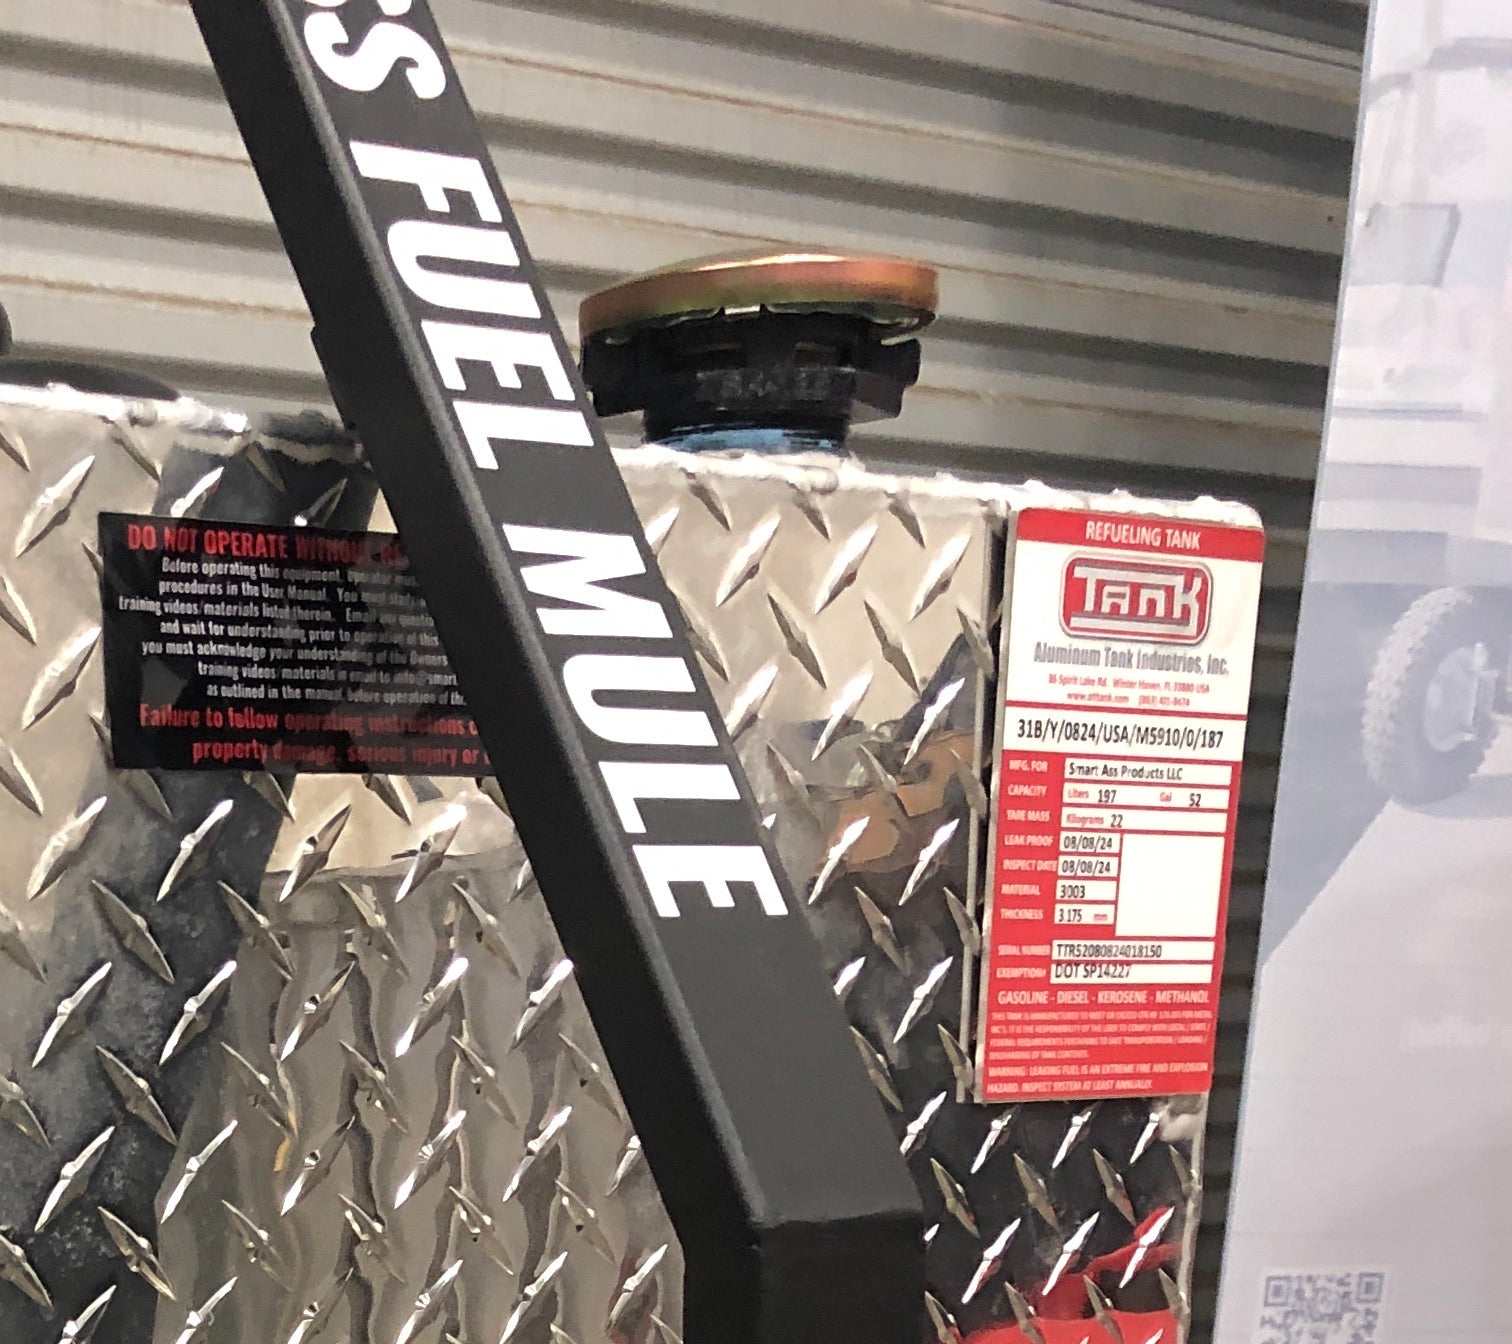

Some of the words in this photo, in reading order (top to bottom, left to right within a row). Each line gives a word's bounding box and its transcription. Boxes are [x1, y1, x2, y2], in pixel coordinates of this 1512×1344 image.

[303, 0, 446, 99] S
[349, 139, 595, 471] FUEL
[127, 524, 157, 550] DO
[164, 526, 198, 553] NOT
[203, 529, 288, 558] OPERATE
[1085, 520, 1161, 547] REFUELING
[1165, 529, 1201, 550] TANK
[161, 556, 199, 574] Before
[201, 561, 257, 580] operating
[259, 564, 280, 579] this
[158, 579, 223, 596] procedures
[226, 581, 238, 595] in
[241, 582, 259, 597] the
[261, 583, 284, 599] User
[337, 587, 359, 602] You
[118, 596, 162, 616] training
[160, 619, 180, 634] and
[182, 620, 206, 636] wait
[208, 621, 224, 636] for
[309, 629, 335, 643] prior
[339, 630, 350, 642] to
[141, 641, 163, 656] you
[166, 641, 194, 655] must
[196, 640, 267, 662] acknowledge
[269, 646, 294, 661] your
[297, 646, 374, 666] understanding
[1034, 642, 1101, 666] Aluminum
[1104, 647, 1133, 668] Tank
[1136, 650, 1204, 675] Industries,
[198, 660, 239, 680] training
[207, 684, 218, 697] as
[221, 684, 265, 699] outlined
[267, 686, 279, 698] in
[282, 685, 302, 700] the
[139, 703, 200, 727] Failure
[206, 707, 223, 727] to
[227, 707, 278, 729] follow
[284, 710, 364, 736] operating
[507, 525, 789, 919] MULE
[1017, 718, 1224, 750] 31B/Y/0824/USA/M5910/0/187
[192, 739, 268, 764] property
[412, 747, 458, 768] injury
[461, 748, 479, 765] or
[1100, 762, 1118, 778] Ass
[1120, 765, 1164, 781] Products
[1166, 766, 1183, 781] LLC
[1008, 784, 1047, 796] CAPACITY
[1097, 789, 1117, 804] 197
[1189, 793, 1201, 808] 52
[1110, 814, 1123, 828] 22
[1063, 835, 1113, 852] 08/08/24
[1061, 859, 1111, 875] 08/08/24
[1060, 884, 1085, 899] 3003
[1055, 963, 1080, 979] DOT
[997, 990, 1049, 1005] GASOLINE
[1057, 991, 1090, 1004] DIESEL
[1097, 990, 1148, 1004] KEROSENE
[1155, 990, 1209, 1004] METHANOL
